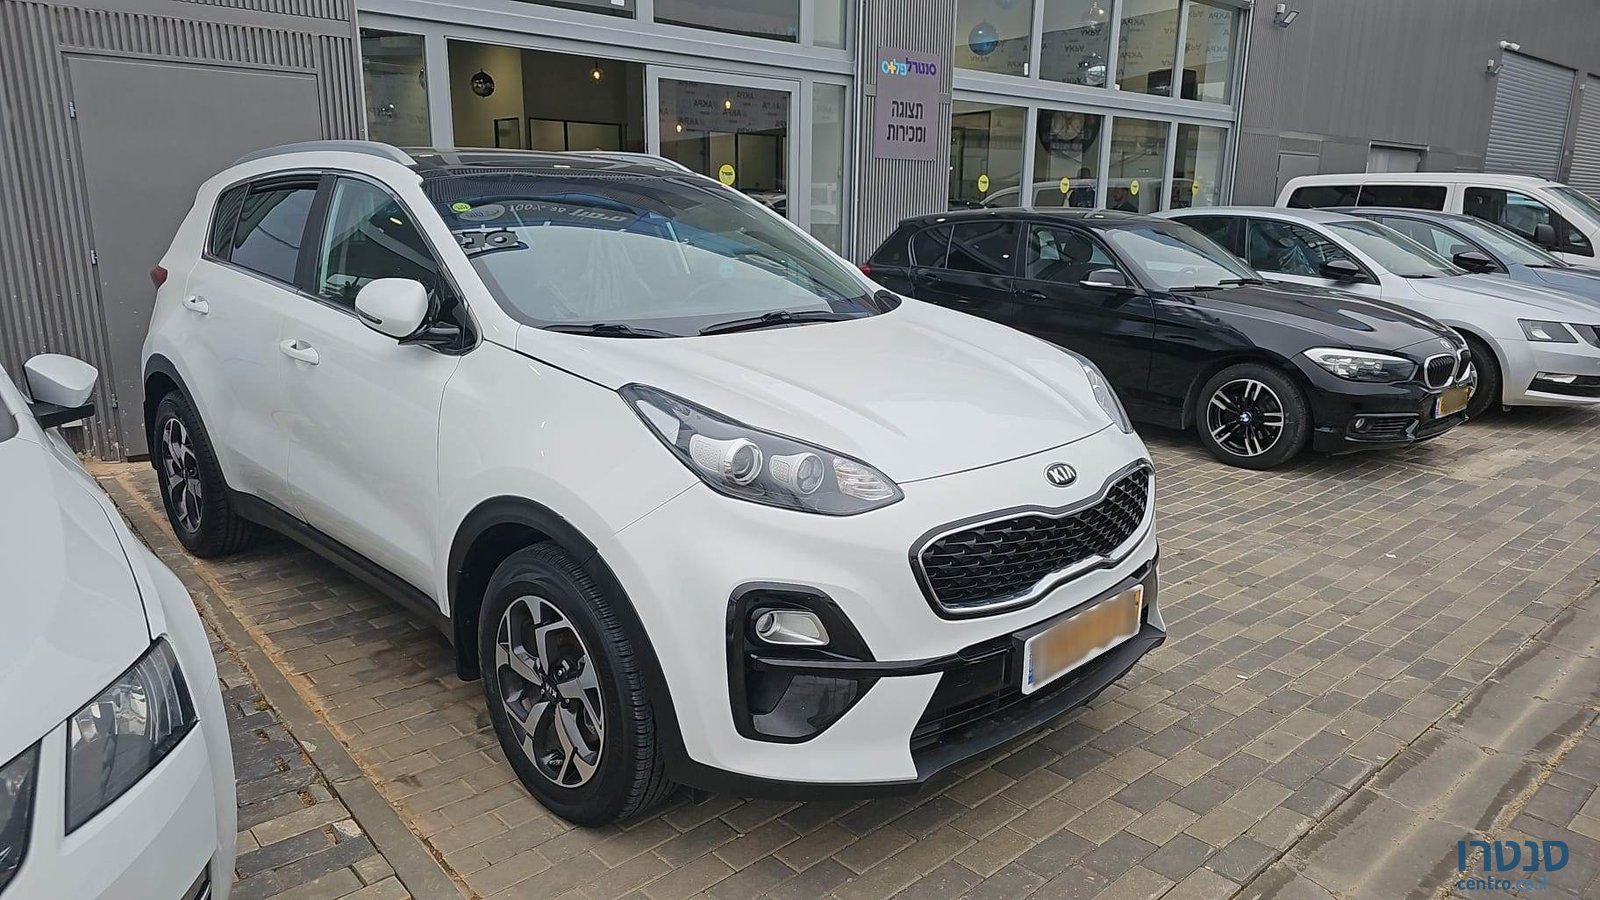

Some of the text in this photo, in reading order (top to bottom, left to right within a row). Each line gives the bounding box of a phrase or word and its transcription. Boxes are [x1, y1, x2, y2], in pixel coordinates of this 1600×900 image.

[891, 100, 923, 120] תצוגה
[887, 124, 926, 143] ומכירות
[1049, 465, 1076, 483] KIA
